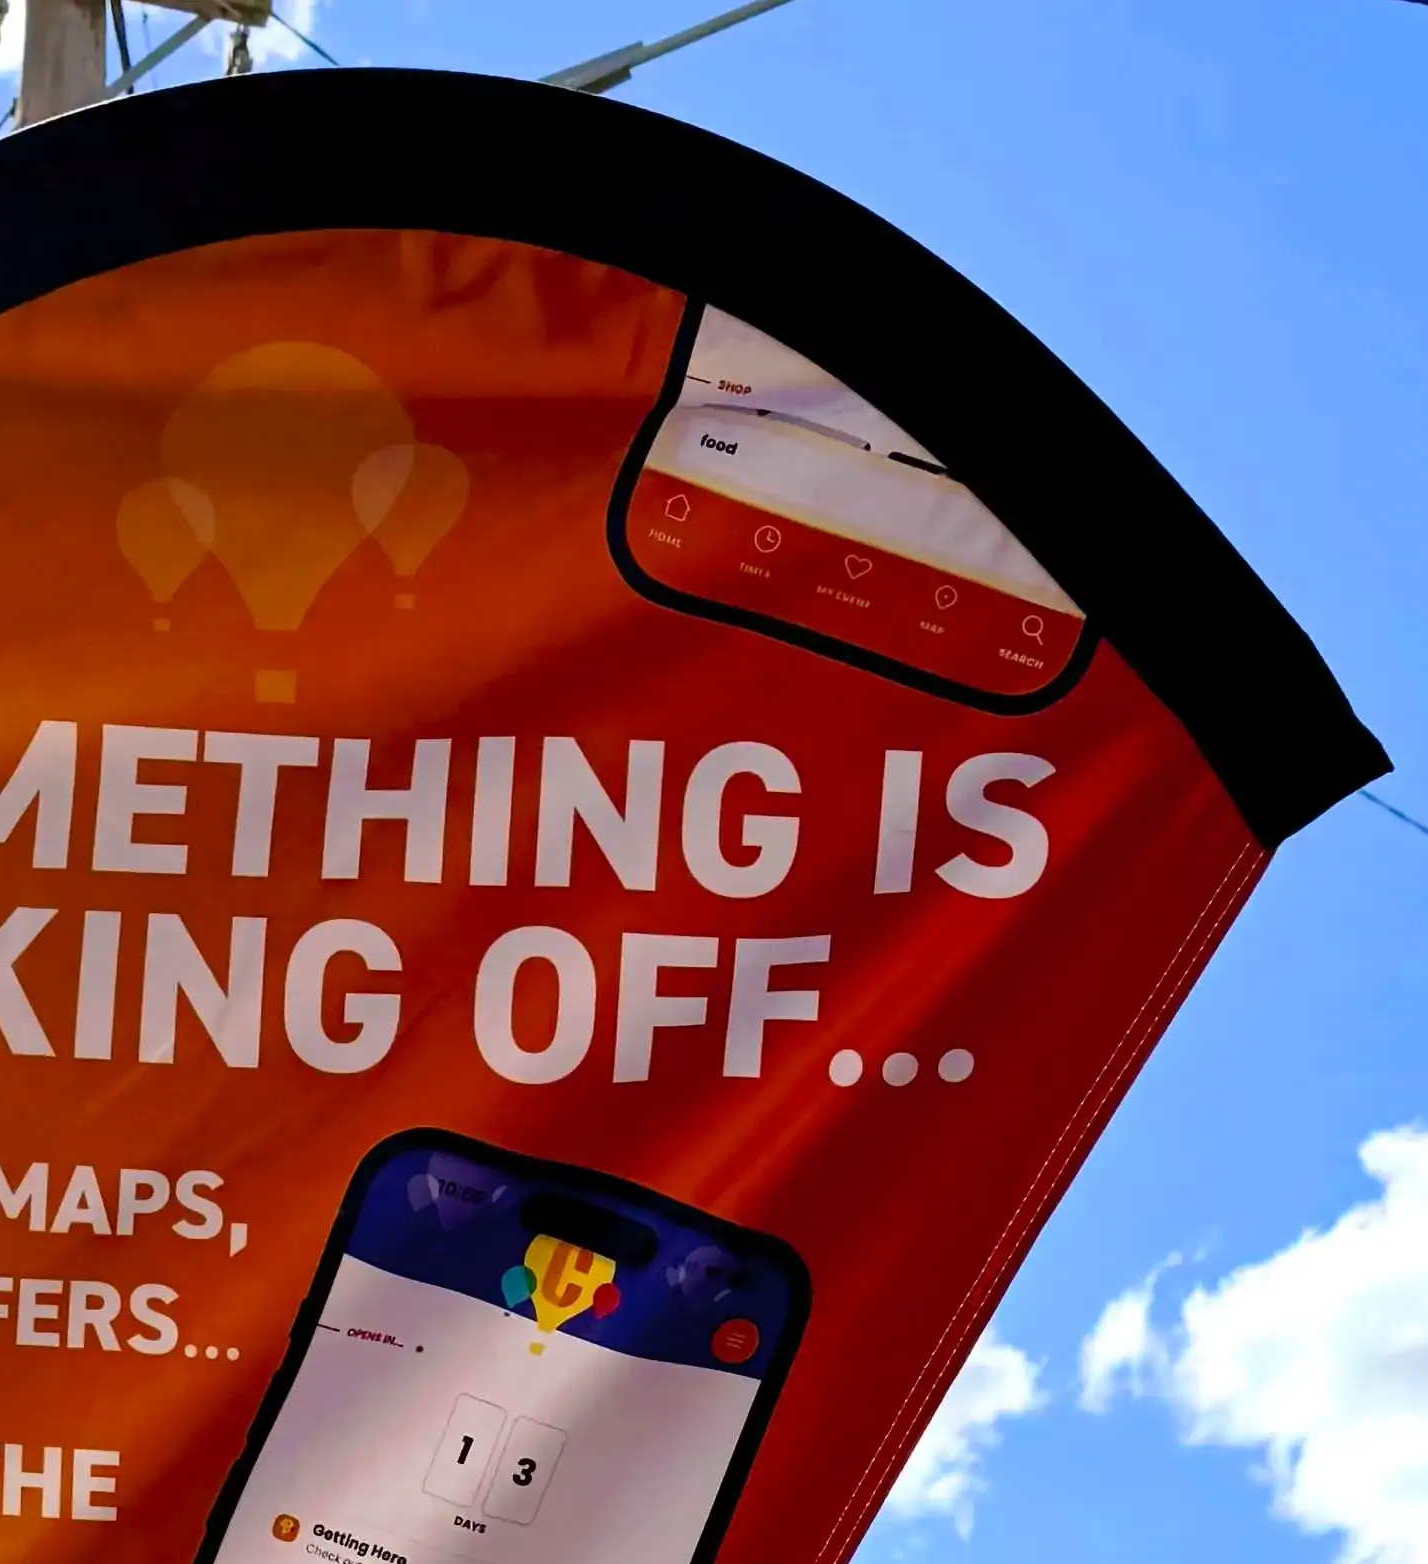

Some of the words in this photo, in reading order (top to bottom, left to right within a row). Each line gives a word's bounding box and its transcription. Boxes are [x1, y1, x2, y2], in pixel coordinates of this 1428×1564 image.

[717, 379, 752, 396] SHOP
[700, 433, 739, 456] food
[648, 527, 684, 549] HOME
[998, 648, 1045, 670] SEARCH
[872, 747, 1057, 901] IS
[473, 924, 974, 1087] OFF...
[346, 1328, 382, 1343] OPENS
[453, 1515, 487, 1534] DAYS
[305, 1543, 341, 1564] Check
